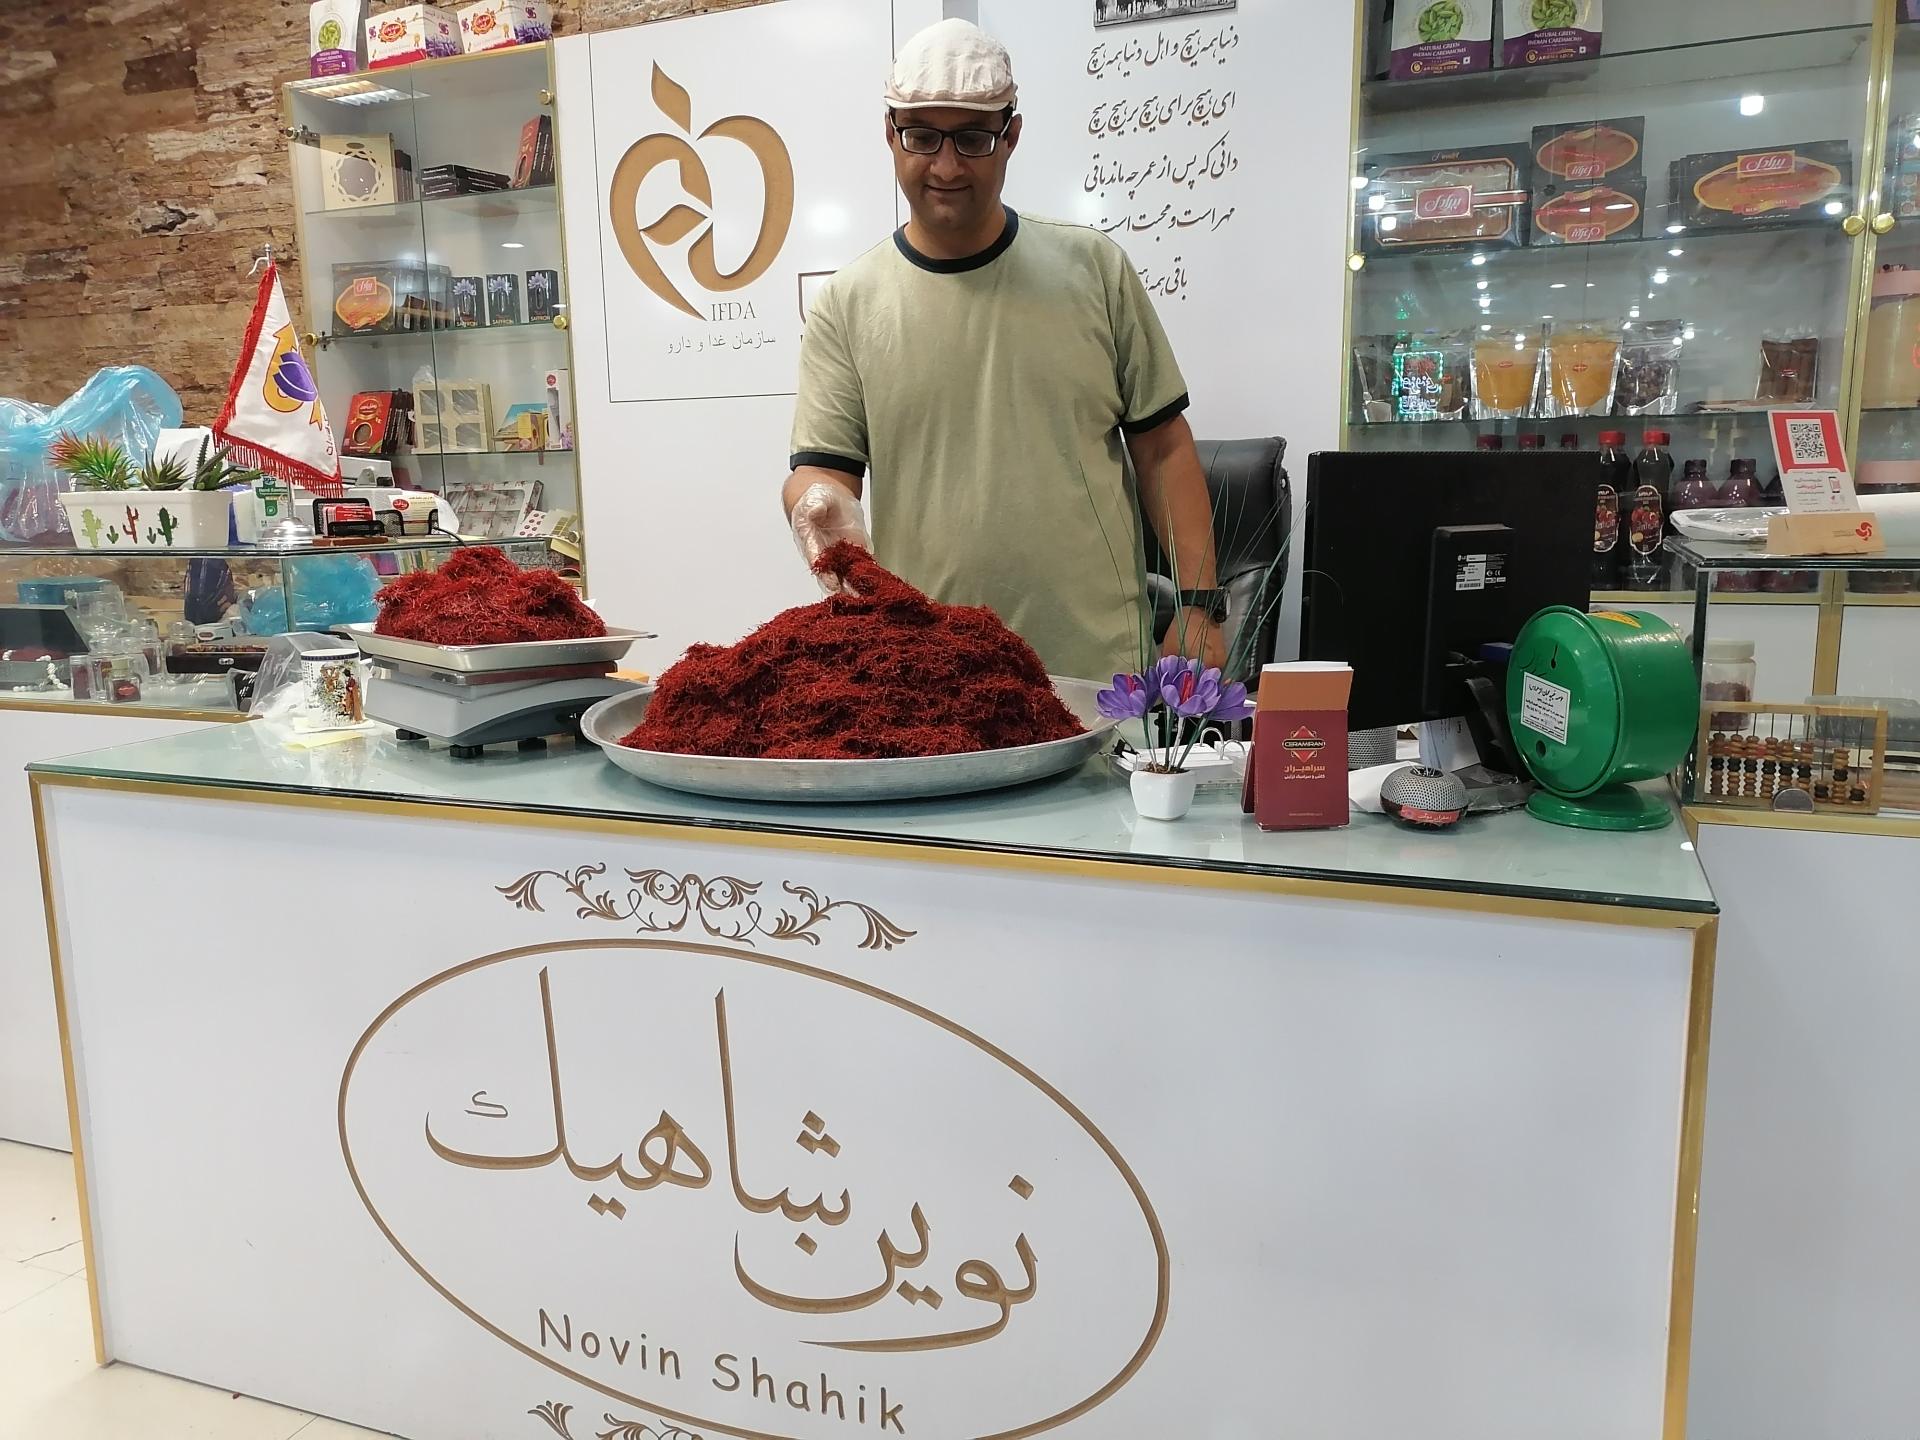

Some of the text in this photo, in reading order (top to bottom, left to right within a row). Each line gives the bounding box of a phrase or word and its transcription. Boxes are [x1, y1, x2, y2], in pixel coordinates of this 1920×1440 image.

[1170, 42, 1179, 56] و
[711, 300, 757, 322] IFDA
[667, 330, 776, 354] سازمان غذا و دارو
[735, 1173, 1038, 1352] نوین
[538, 1308, 906, 1434] Novin Shahik
